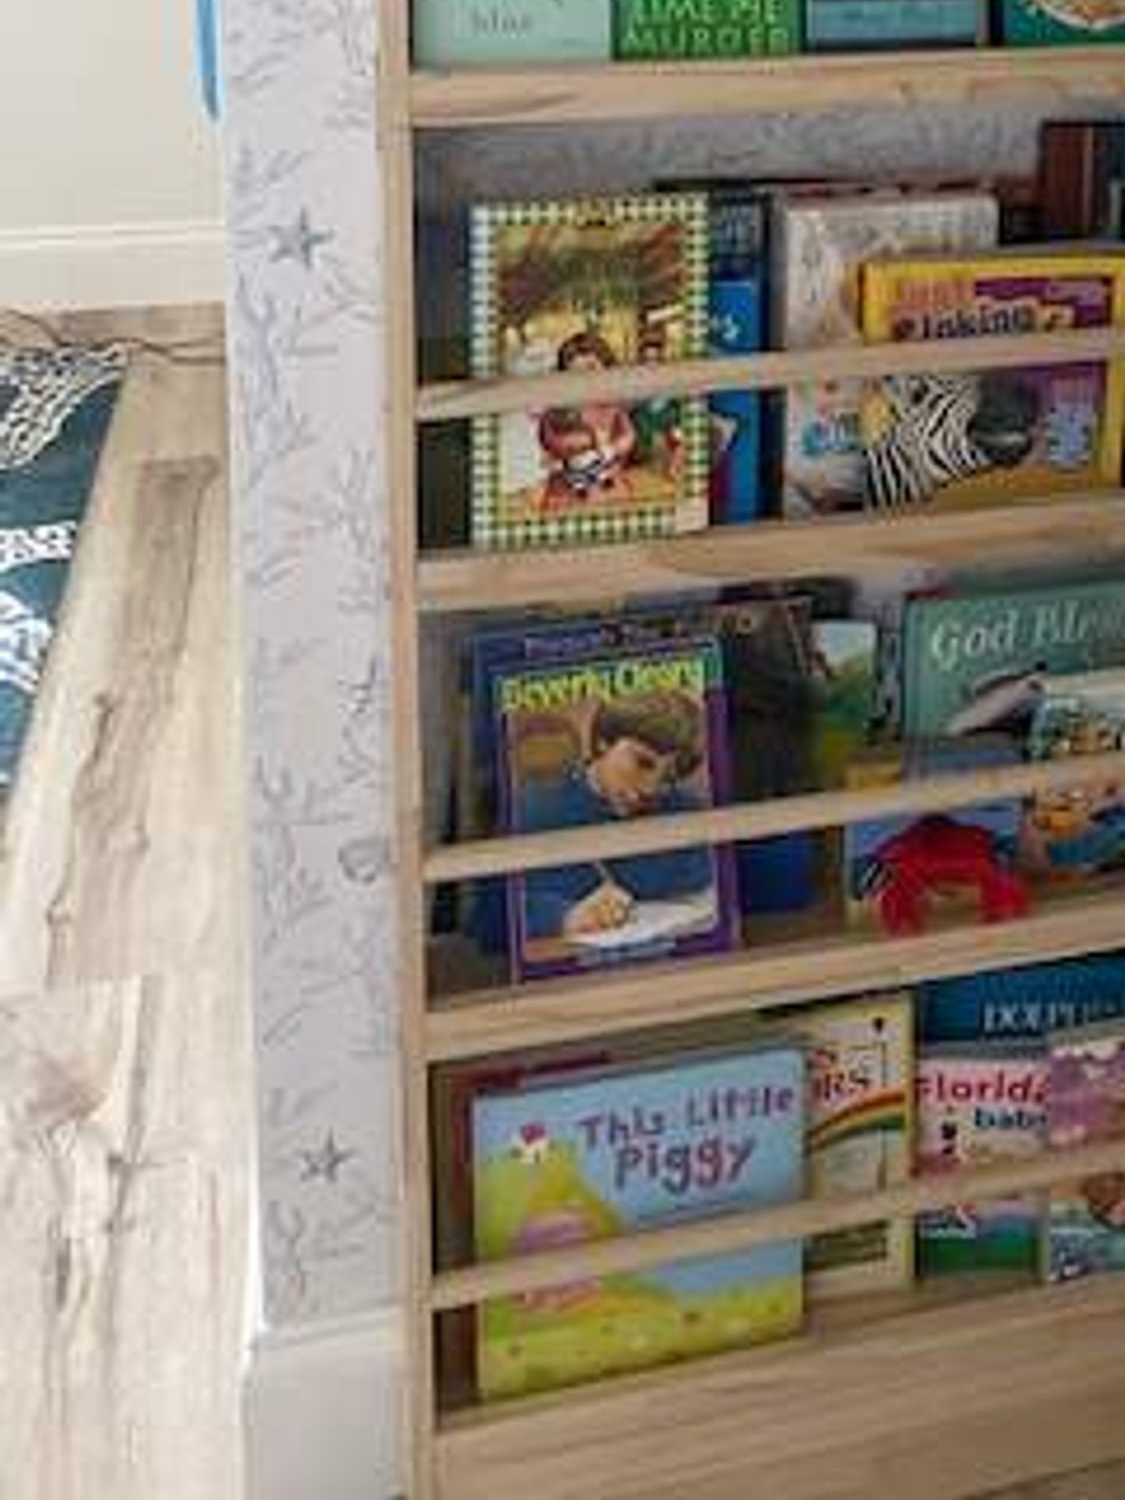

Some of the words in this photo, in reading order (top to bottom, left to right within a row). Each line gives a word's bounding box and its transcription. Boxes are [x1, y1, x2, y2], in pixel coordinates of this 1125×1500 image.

[930, 607, 1019, 672] God
[578, 1106, 667, 1146] This
[684, 1083, 796, 1128] Little
